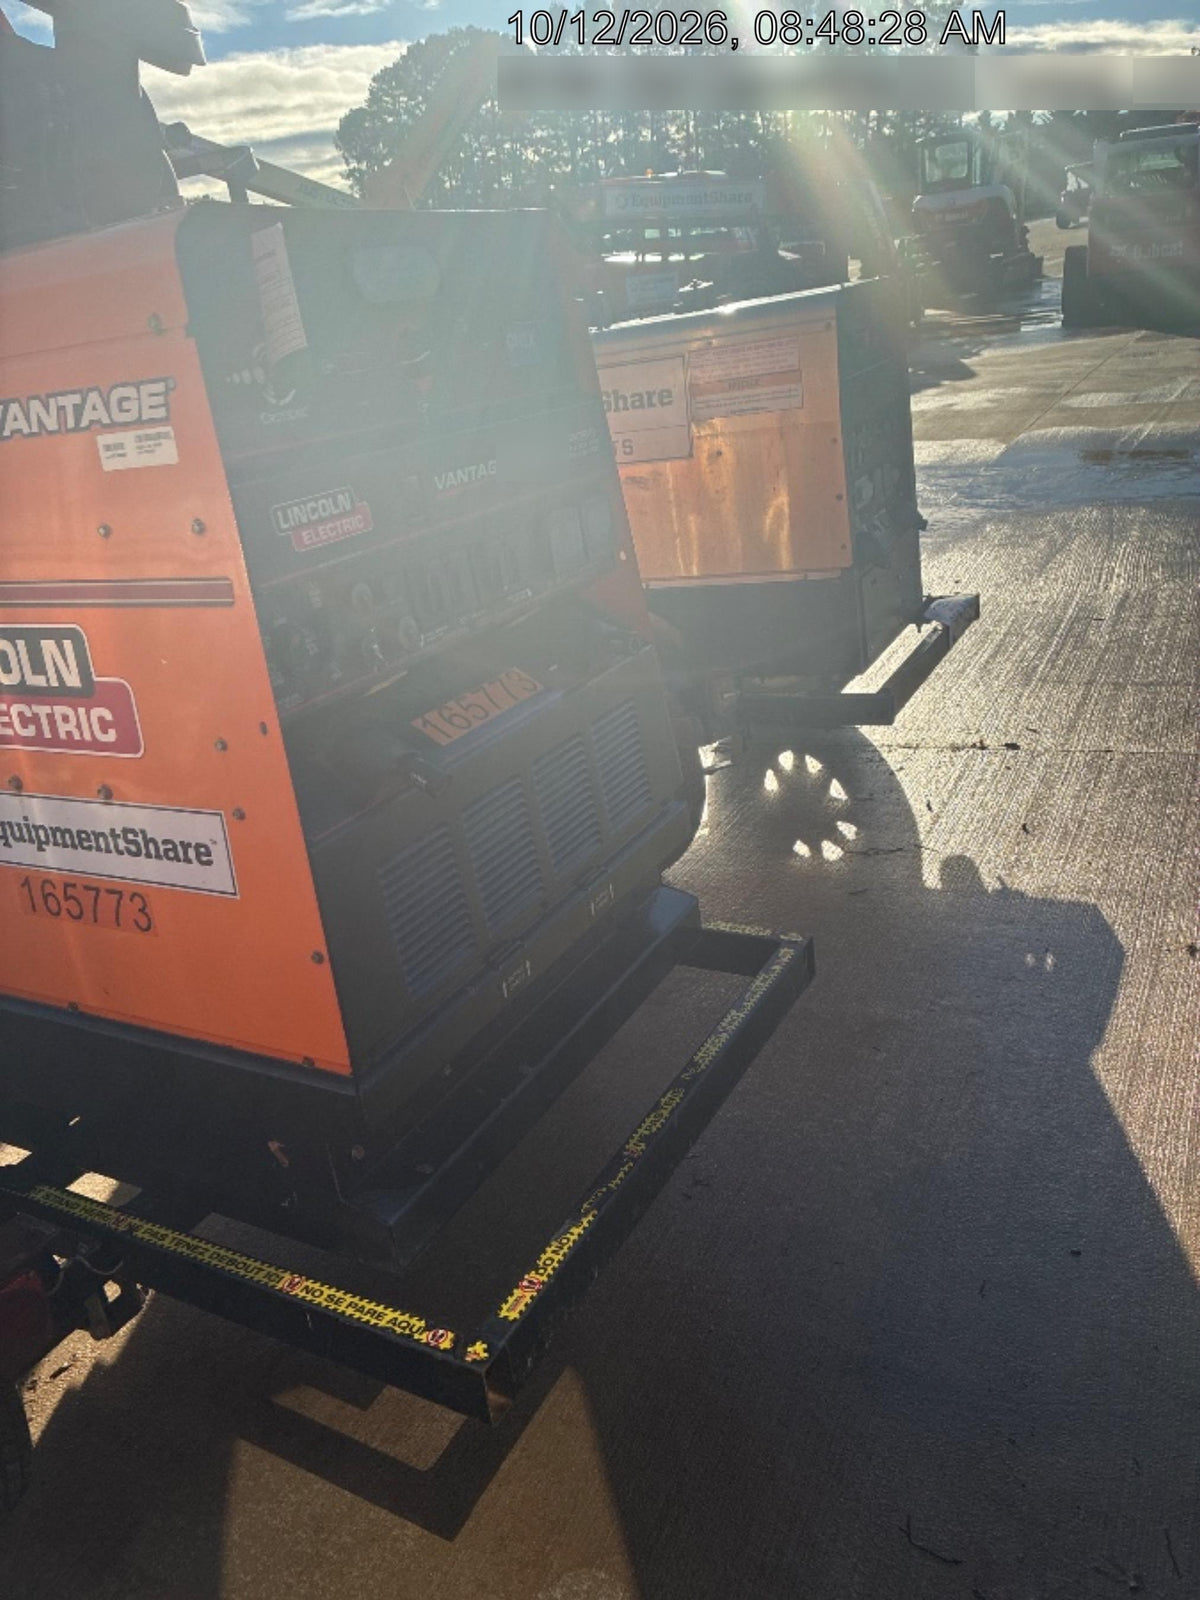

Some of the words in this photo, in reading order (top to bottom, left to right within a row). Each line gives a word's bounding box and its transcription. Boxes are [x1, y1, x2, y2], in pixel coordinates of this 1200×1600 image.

[277, 491, 351, 530] LINCOLN
[302, 514, 366, 546] ELECTRIC
[421, 670, 538, 739] 165773
[20, 876, 153, 932] 165773
[535, 1256, 556, 1276] DO
[300, 1285, 325, 1299] NO
[325, 1292, 347, 1306] SE
[346, 1300, 389, 1322] PARE
